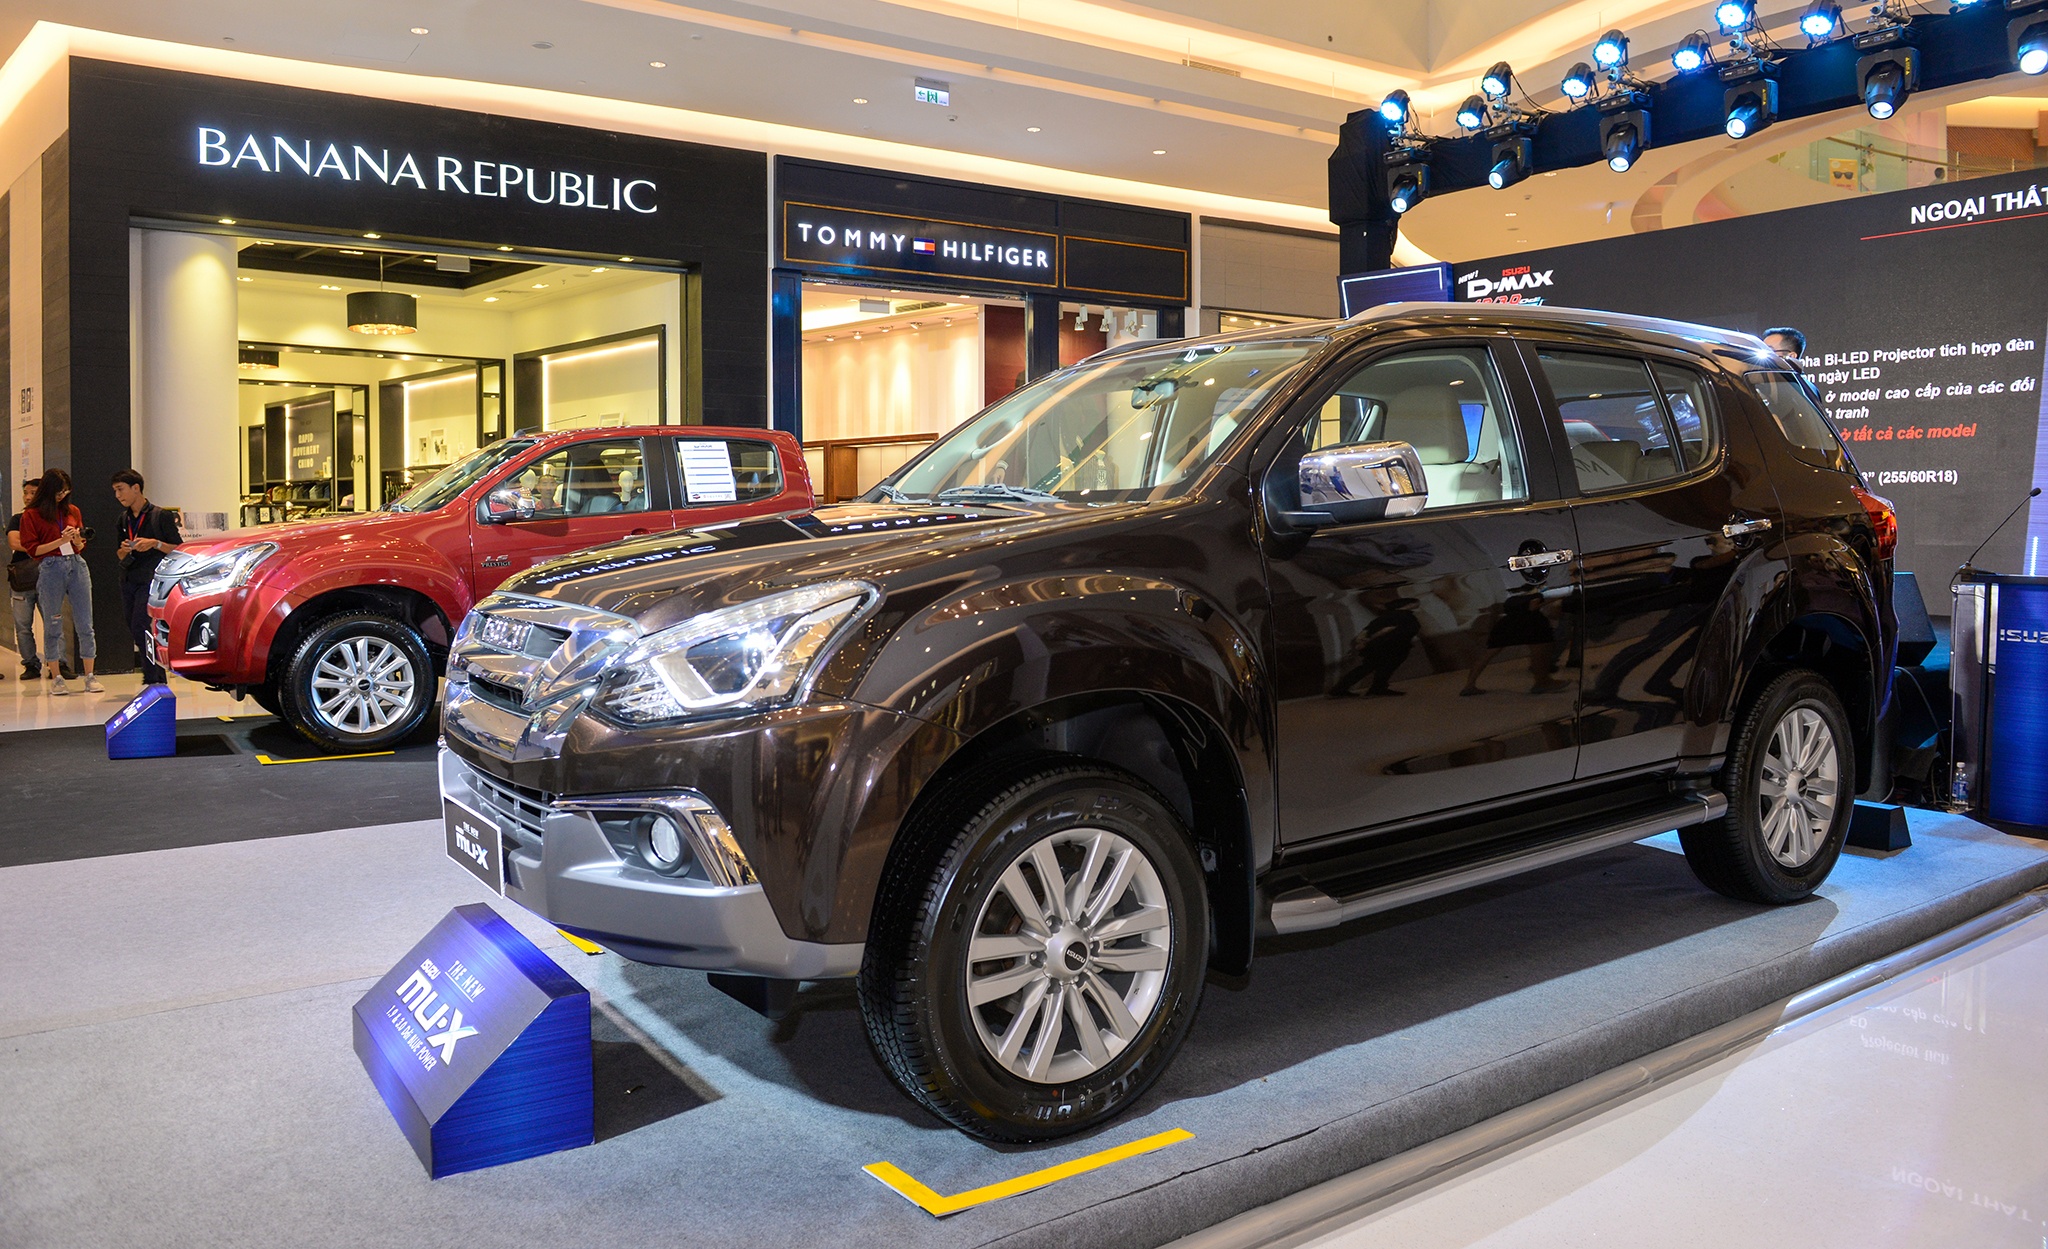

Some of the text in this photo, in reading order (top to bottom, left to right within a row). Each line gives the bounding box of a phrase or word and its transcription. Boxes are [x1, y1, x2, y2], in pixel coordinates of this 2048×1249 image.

[198, 126, 658, 214] BANANA REPUBLIC
[1910, 195, 1985, 225] NGOẠI
[798, 223, 1049, 268] TOMMY HILFIGER
[1458, 269, 1479, 285] NEW!
[1501, 265, 1531, 277] ISUZU
[1467, 269, 1554, 299] D-MAX
[1824, 350, 1870, 367] Bi-LED
[1873, 345, 1936, 365] Projector
[1939, 343, 1967, 358] tích
[1971, 340, 2001, 358] hợp
[2005, 337, 2034, 352] đèn
[1818, 369, 1850, 385] ngày
[1853, 366, 1881, 381] LED
[1825, 376, 2036, 403] ở model cao cấp của các đối
[1835, 406, 1870, 420] tranh
[1853, 424, 1873, 442] tất
[1875, 426, 1894, 441] cả
[1896, 425, 1924, 440] các
[1926, 422, 1977, 439] model
[292, 444, 320, 457] MOVEMENT
[297, 457, 314, 469] CHINO
[1878, 469, 1958, 486] (255/60R18)
[1066, 949, 1086, 963] ISUZU
[420, 958, 441, 980] ISUZU
[447, 960, 486, 999] THE NEW
[407, 1033, 424, 1053] BLUE
[416, 1045, 438, 1072] POWER
